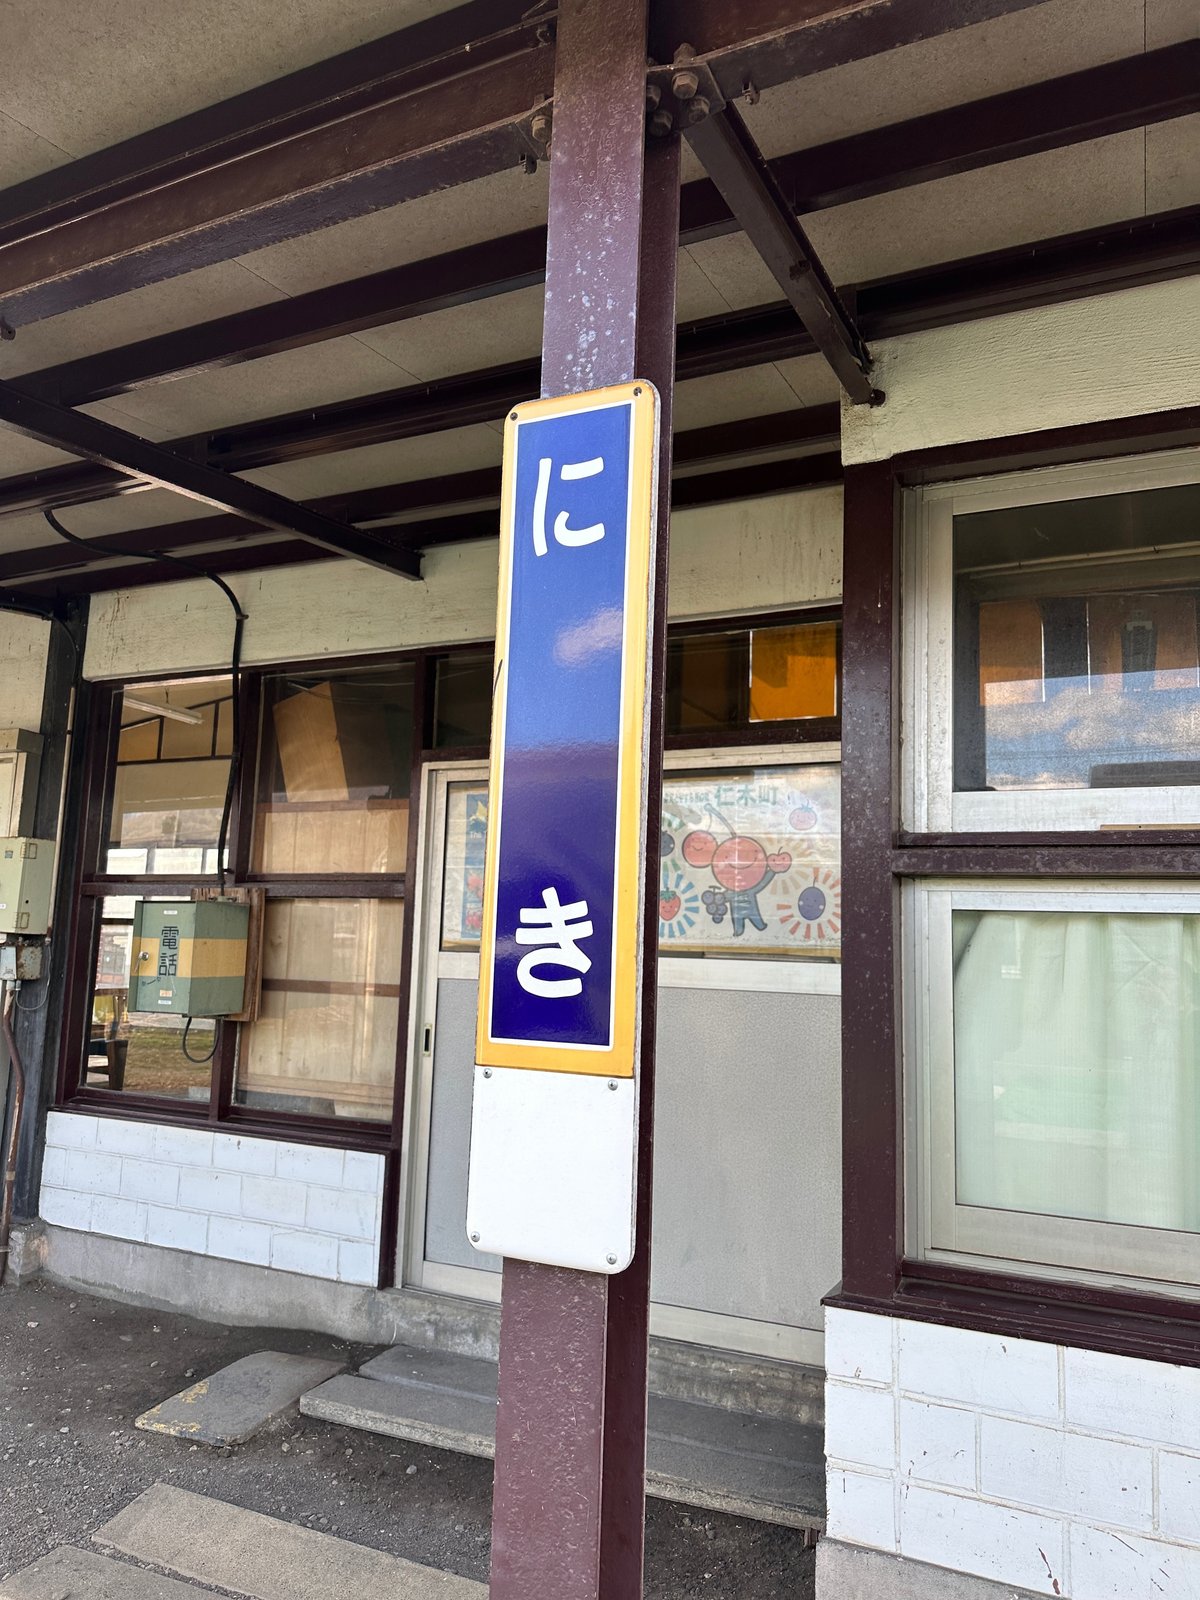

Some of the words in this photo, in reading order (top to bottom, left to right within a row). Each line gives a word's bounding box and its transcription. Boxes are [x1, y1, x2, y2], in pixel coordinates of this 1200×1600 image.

[516, 456, 605, 999] にき
[714, 784, 779, 807] 仁木町
[158, 925, 179, 977] 電話
